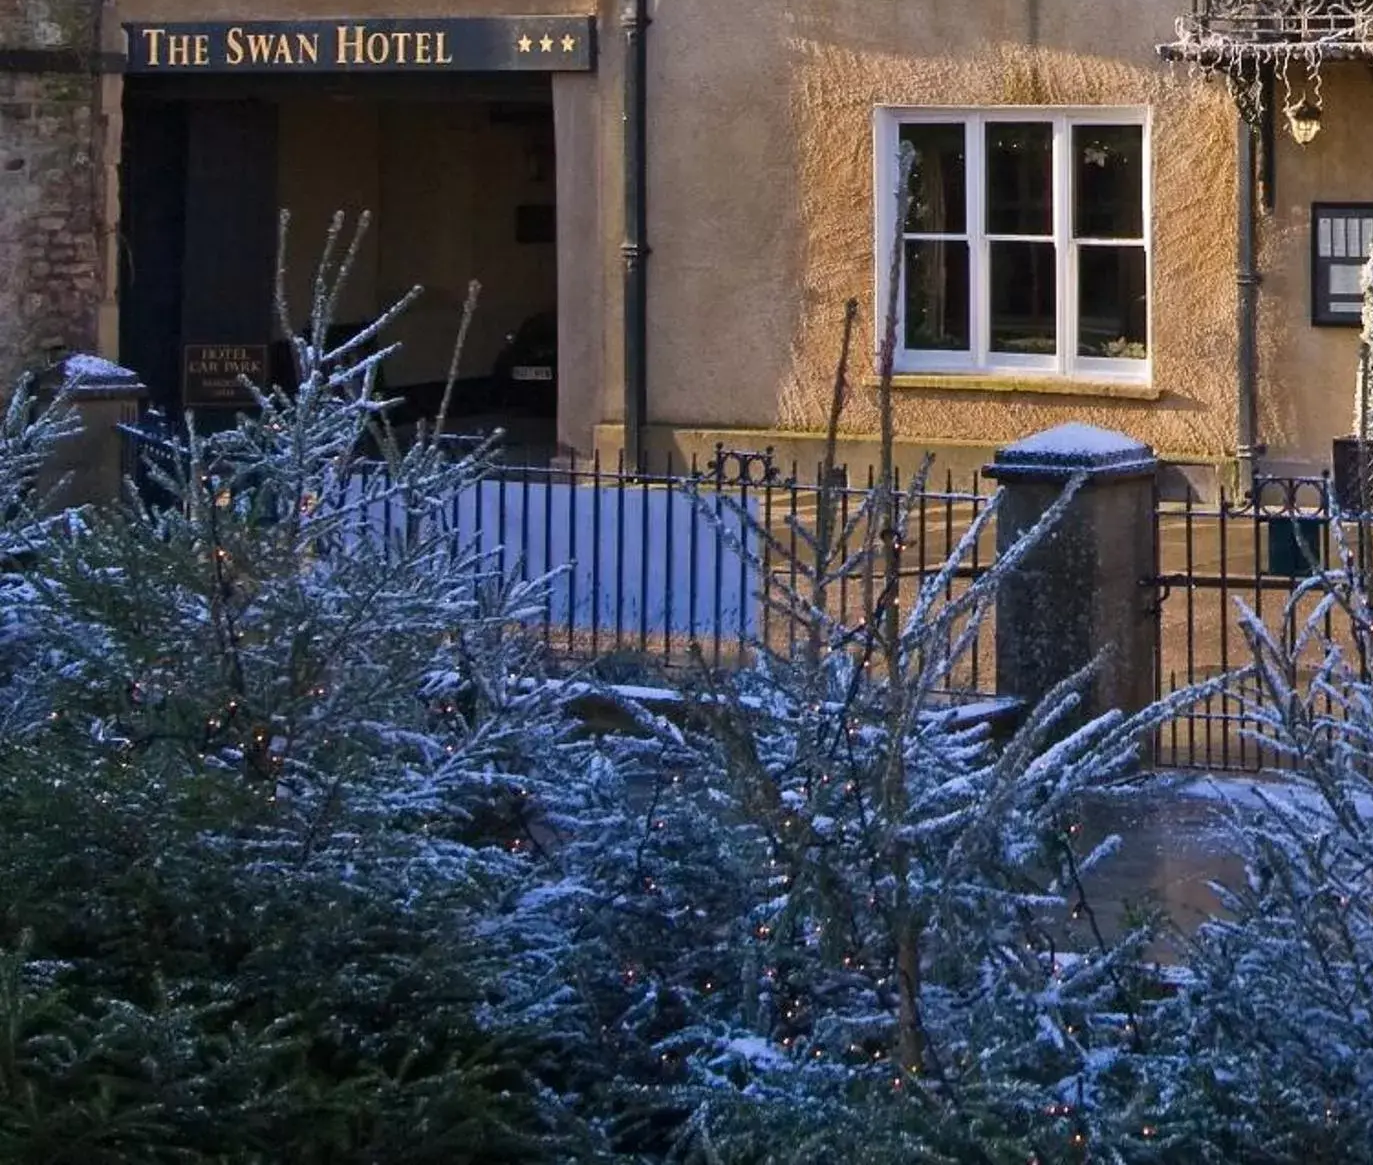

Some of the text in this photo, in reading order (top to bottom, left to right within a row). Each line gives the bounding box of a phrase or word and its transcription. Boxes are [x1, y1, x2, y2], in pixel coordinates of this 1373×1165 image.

[143, 24, 453, 66] THE SWAN HOTEL
